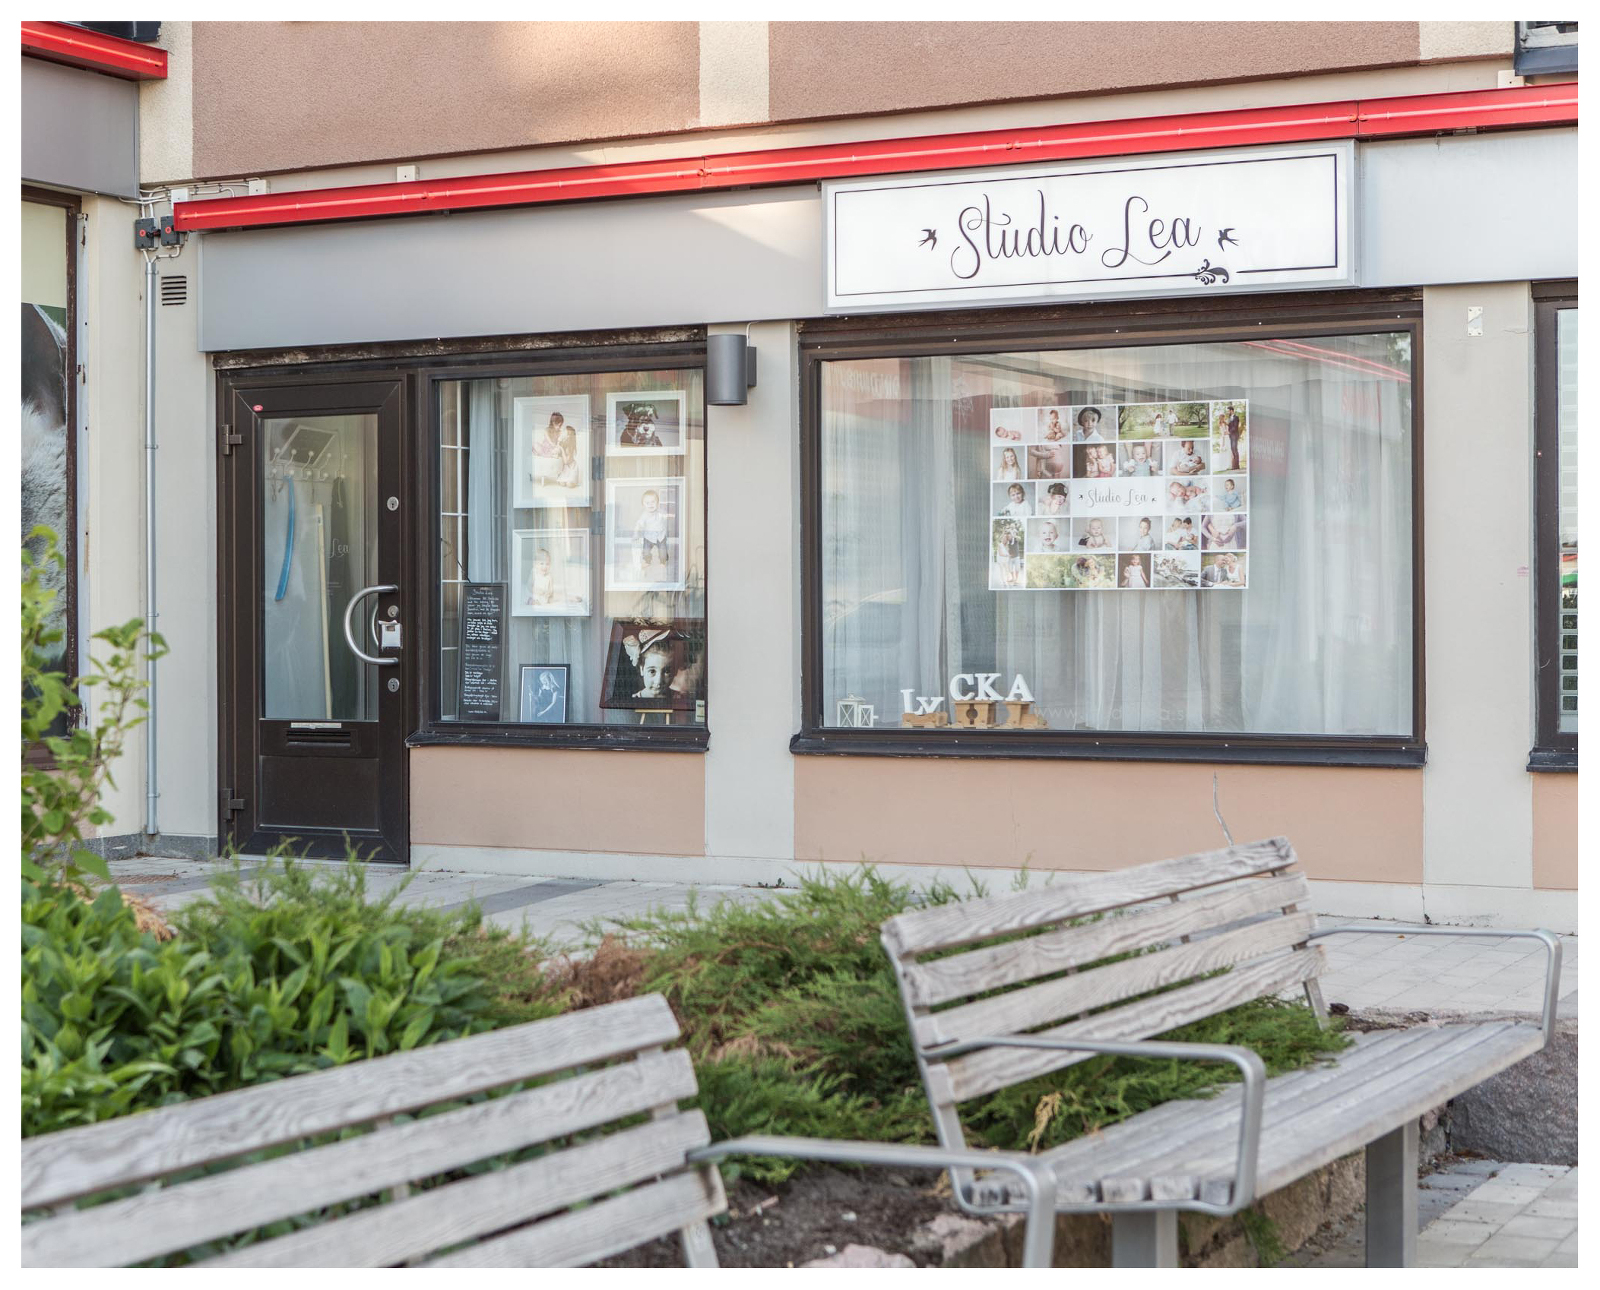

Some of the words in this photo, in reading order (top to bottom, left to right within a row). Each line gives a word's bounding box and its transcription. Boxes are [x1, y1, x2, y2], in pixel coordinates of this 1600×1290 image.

[950, 189, 1094, 279] Studio
[1101, 196, 1201, 268] Lea
[1086, 486, 1121, 508] Studio
[1124, 488, 1148, 507] Lea
[329, 538, 351, 559] Lea
